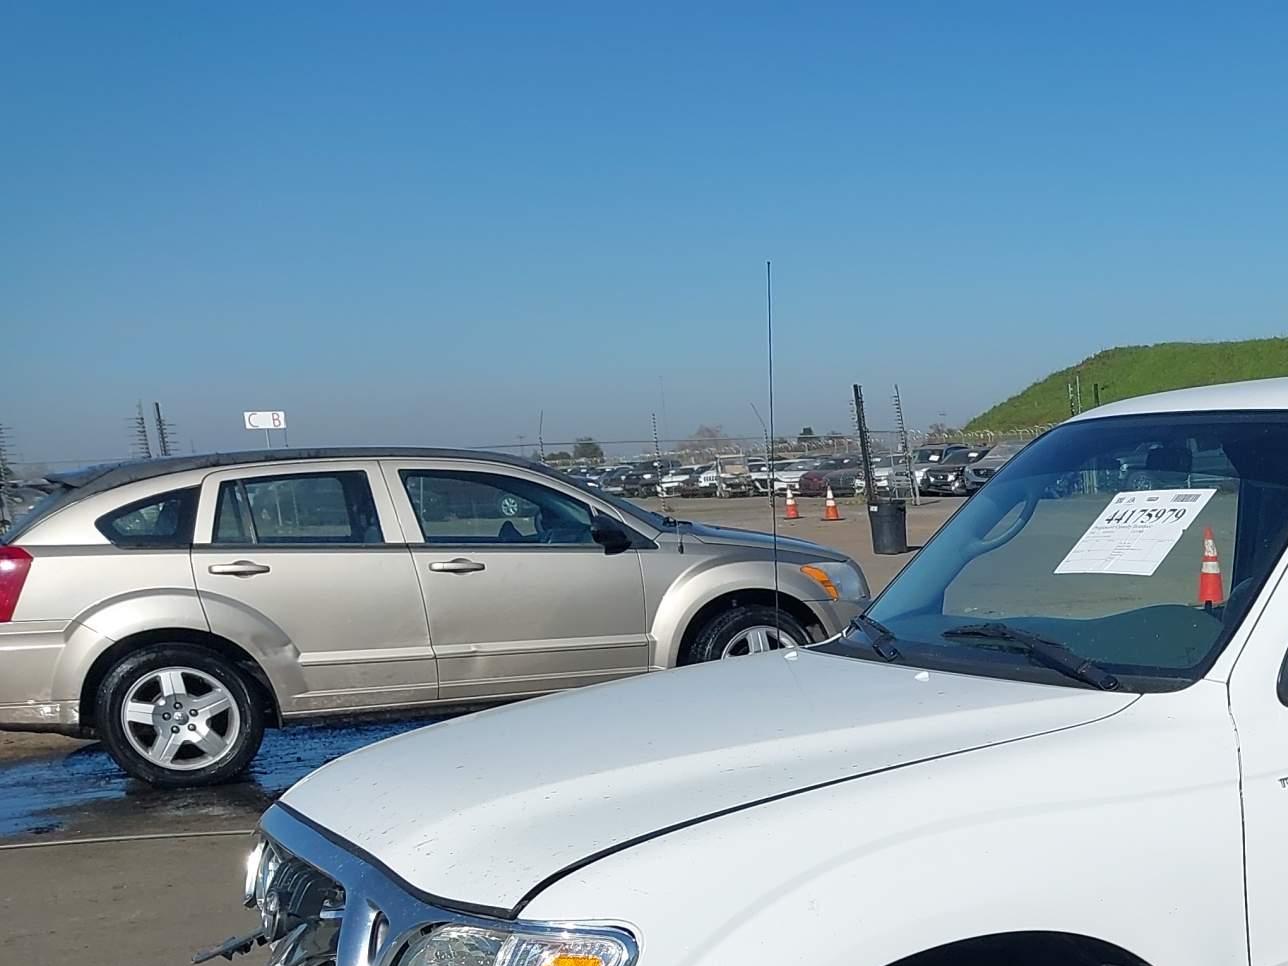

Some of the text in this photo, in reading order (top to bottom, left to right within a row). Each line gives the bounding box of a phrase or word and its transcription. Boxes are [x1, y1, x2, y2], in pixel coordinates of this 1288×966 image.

[249, 413, 281, 427] C B
[1105, 508, 1186, 524] 44175979
